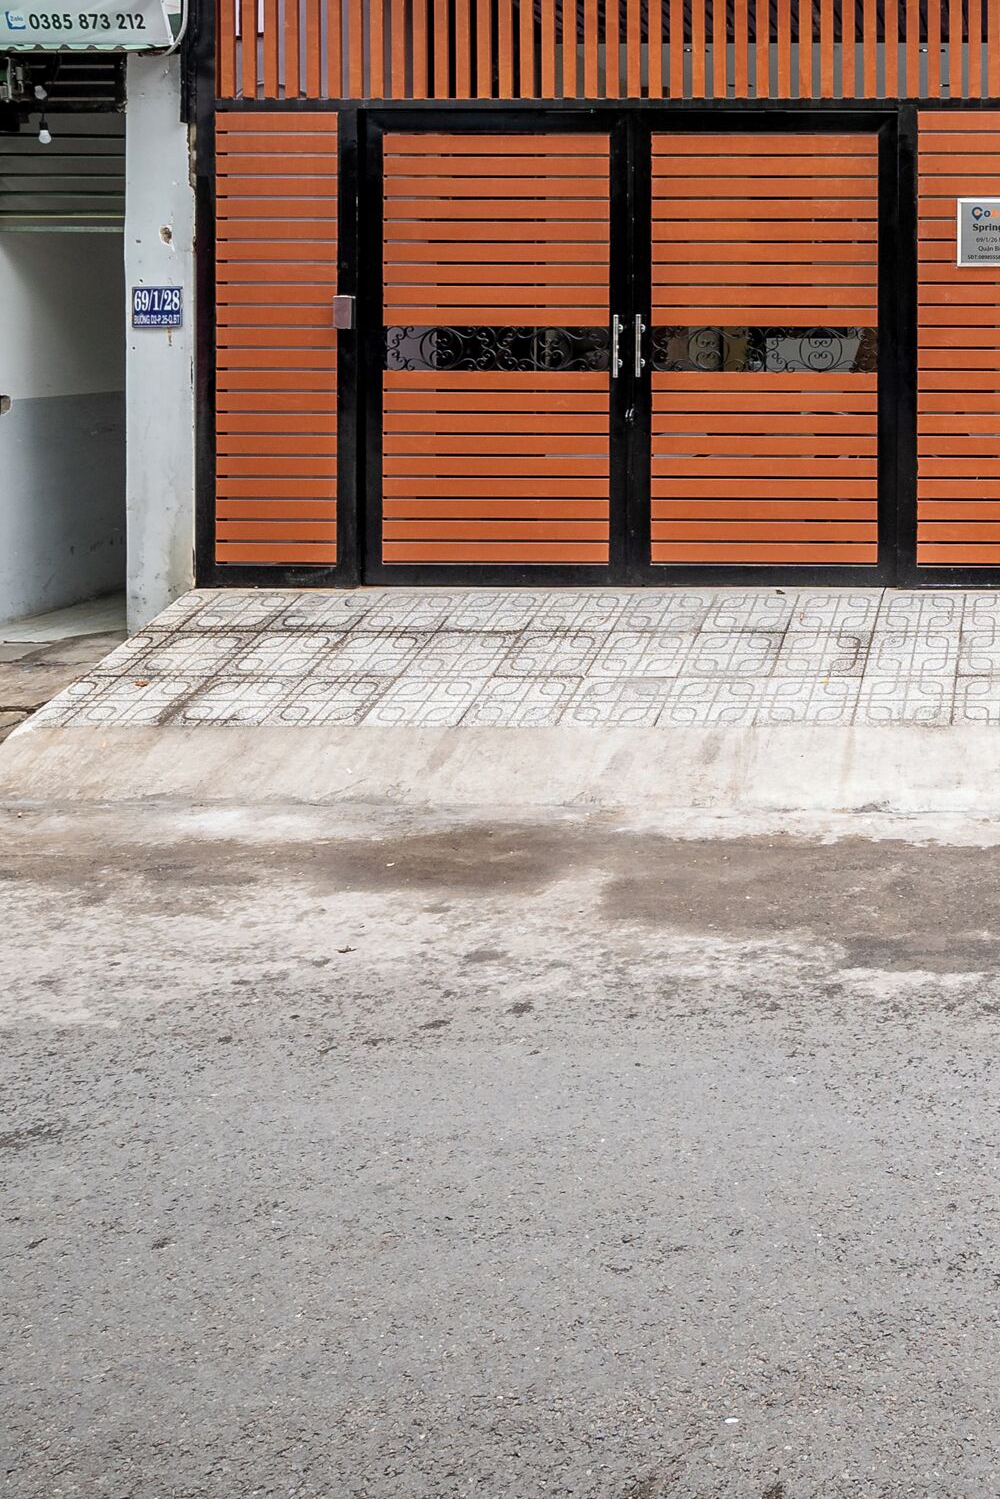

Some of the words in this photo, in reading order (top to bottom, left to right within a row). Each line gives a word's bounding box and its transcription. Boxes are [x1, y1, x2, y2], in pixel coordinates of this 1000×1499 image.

[28, 13, 73, 30] 0385
[79, 13, 111, 30] 873
[116, 13, 146, 30] 212
[134, 290, 180, 311] 69/1/28
